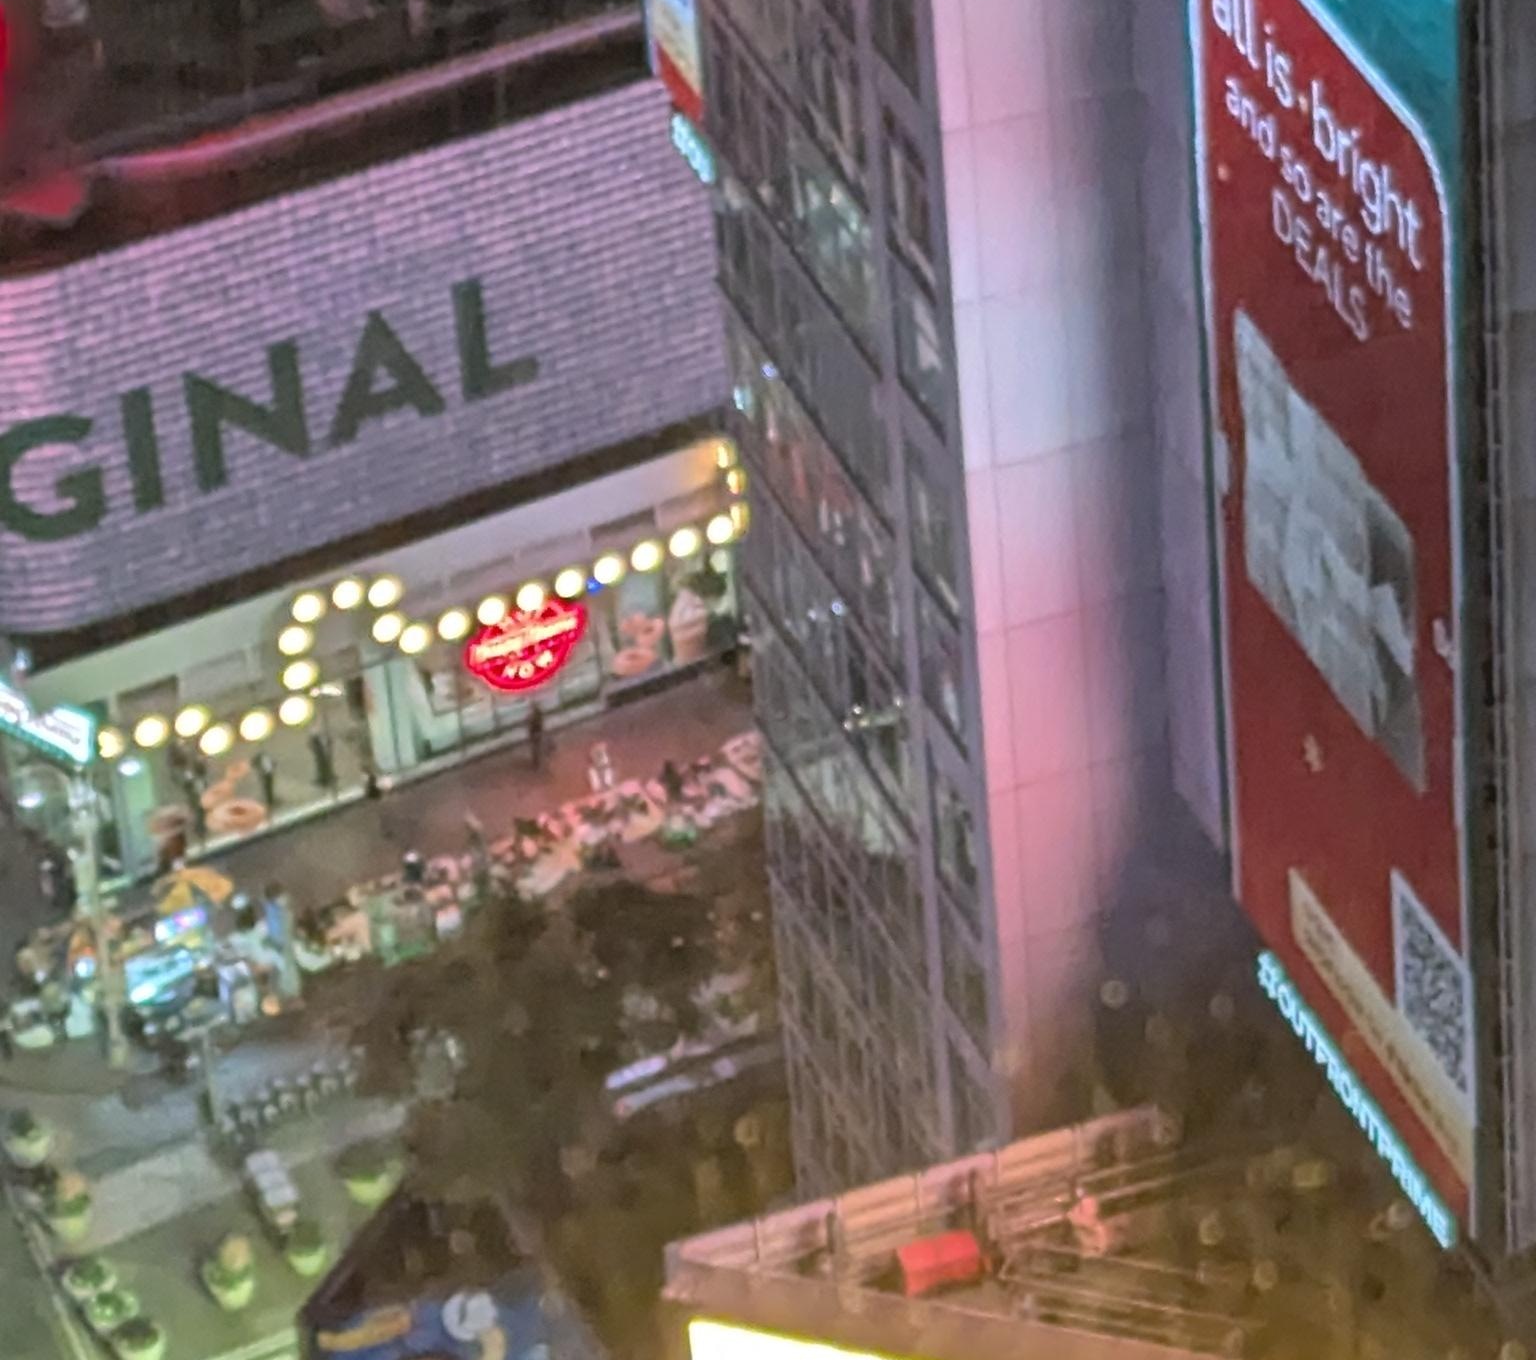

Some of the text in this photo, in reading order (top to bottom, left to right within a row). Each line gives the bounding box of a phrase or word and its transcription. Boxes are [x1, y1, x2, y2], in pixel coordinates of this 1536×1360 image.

[1225, 76, 1277, 160] and
[1315, 190, 1360, 264] are
[1364, 240, 1414, 330] the
[1263, 22, 1295, 109] is
[1311, 78, 1424, 272] bright
[1271, 186, 1370, 342] DEALS
[0, 276, 539, 541] GINAL
